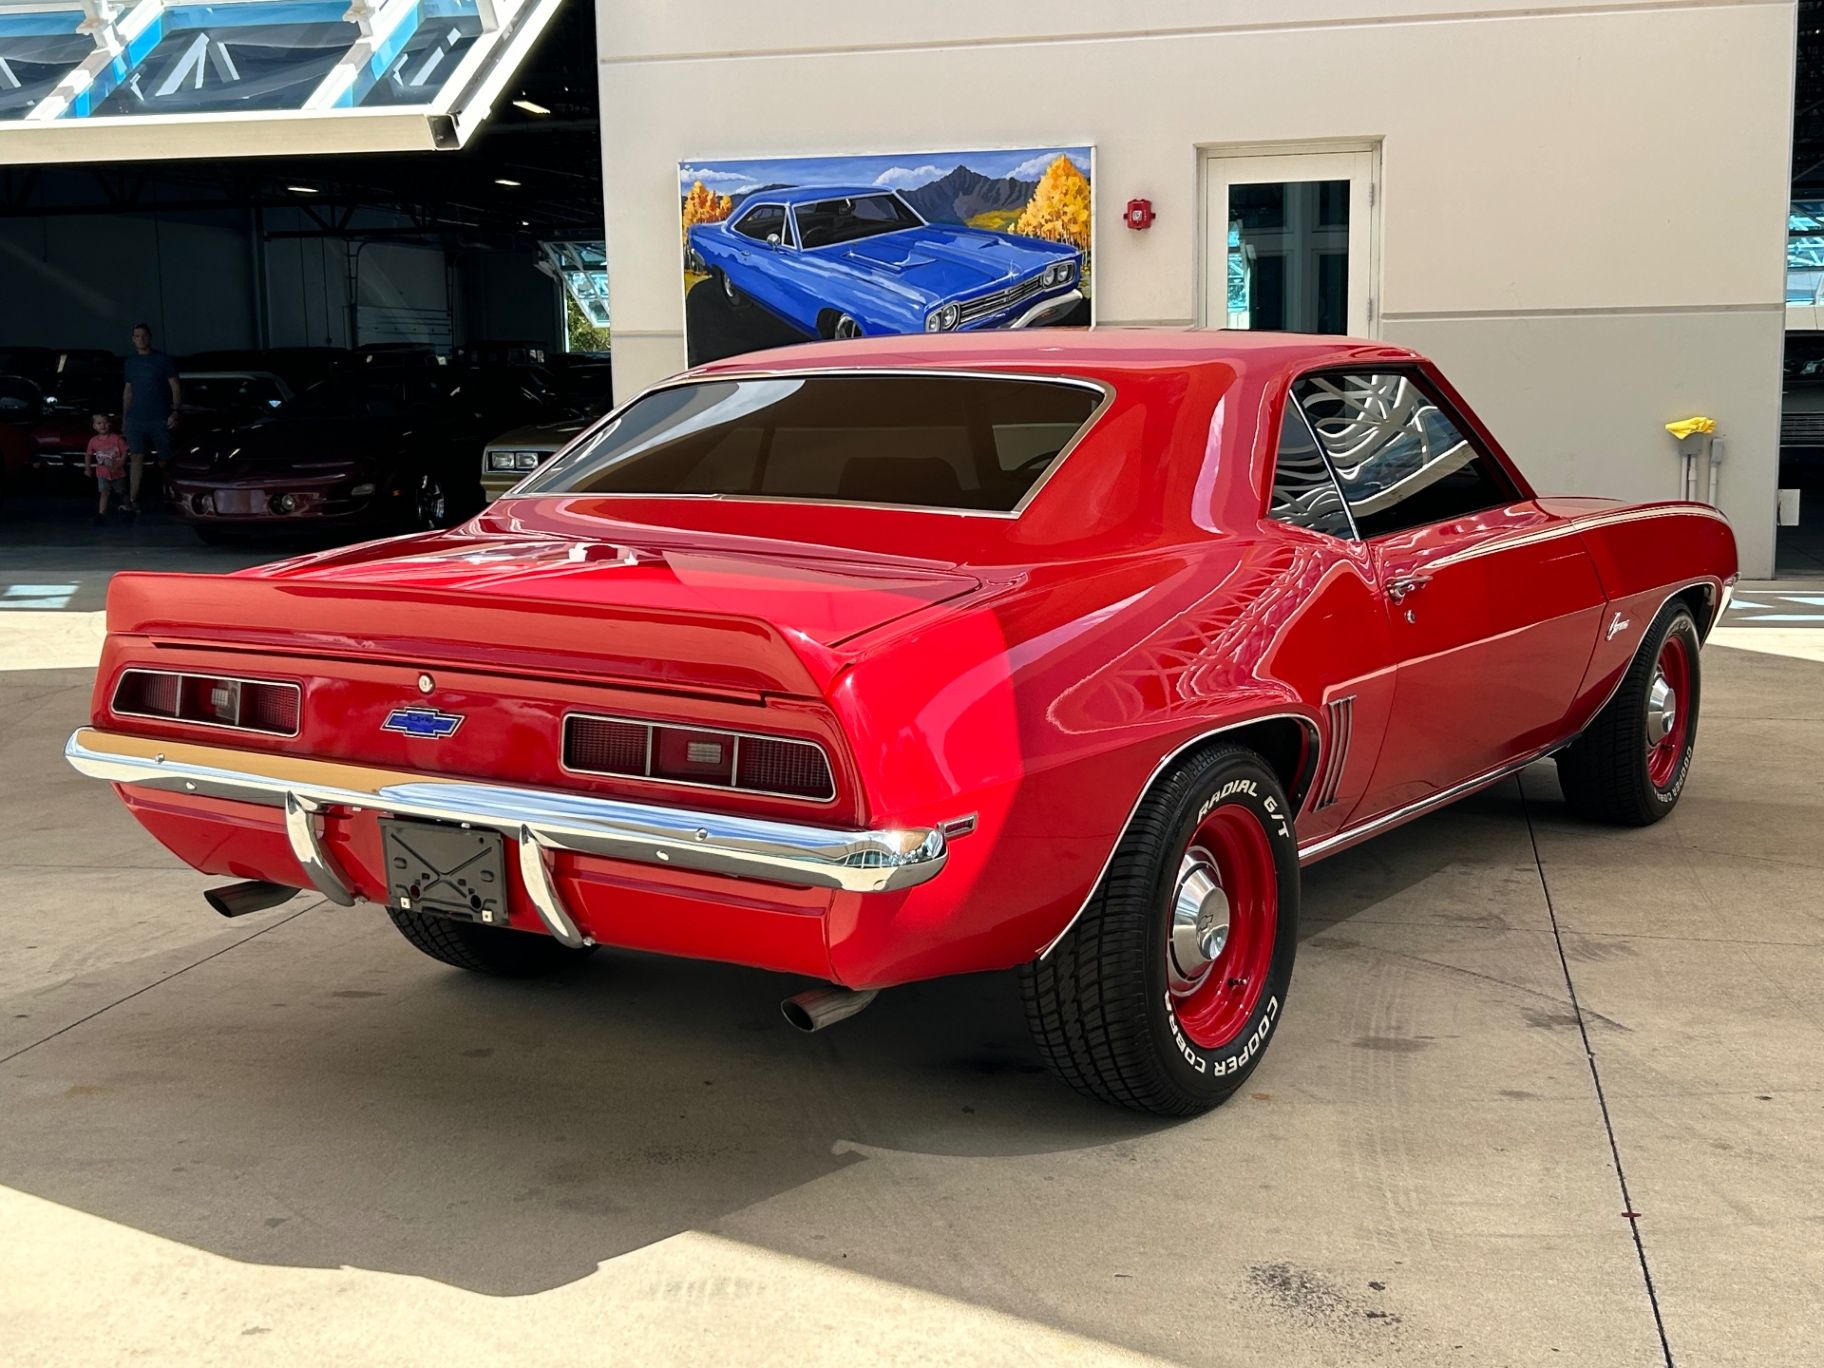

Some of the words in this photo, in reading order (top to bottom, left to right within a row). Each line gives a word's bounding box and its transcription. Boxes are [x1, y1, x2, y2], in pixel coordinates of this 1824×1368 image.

[1197, 779, 1258, 825] RADIAL
[1263, 795, 1290, 838] G/T
[1214, 995, 1278, 1077] COOPER
